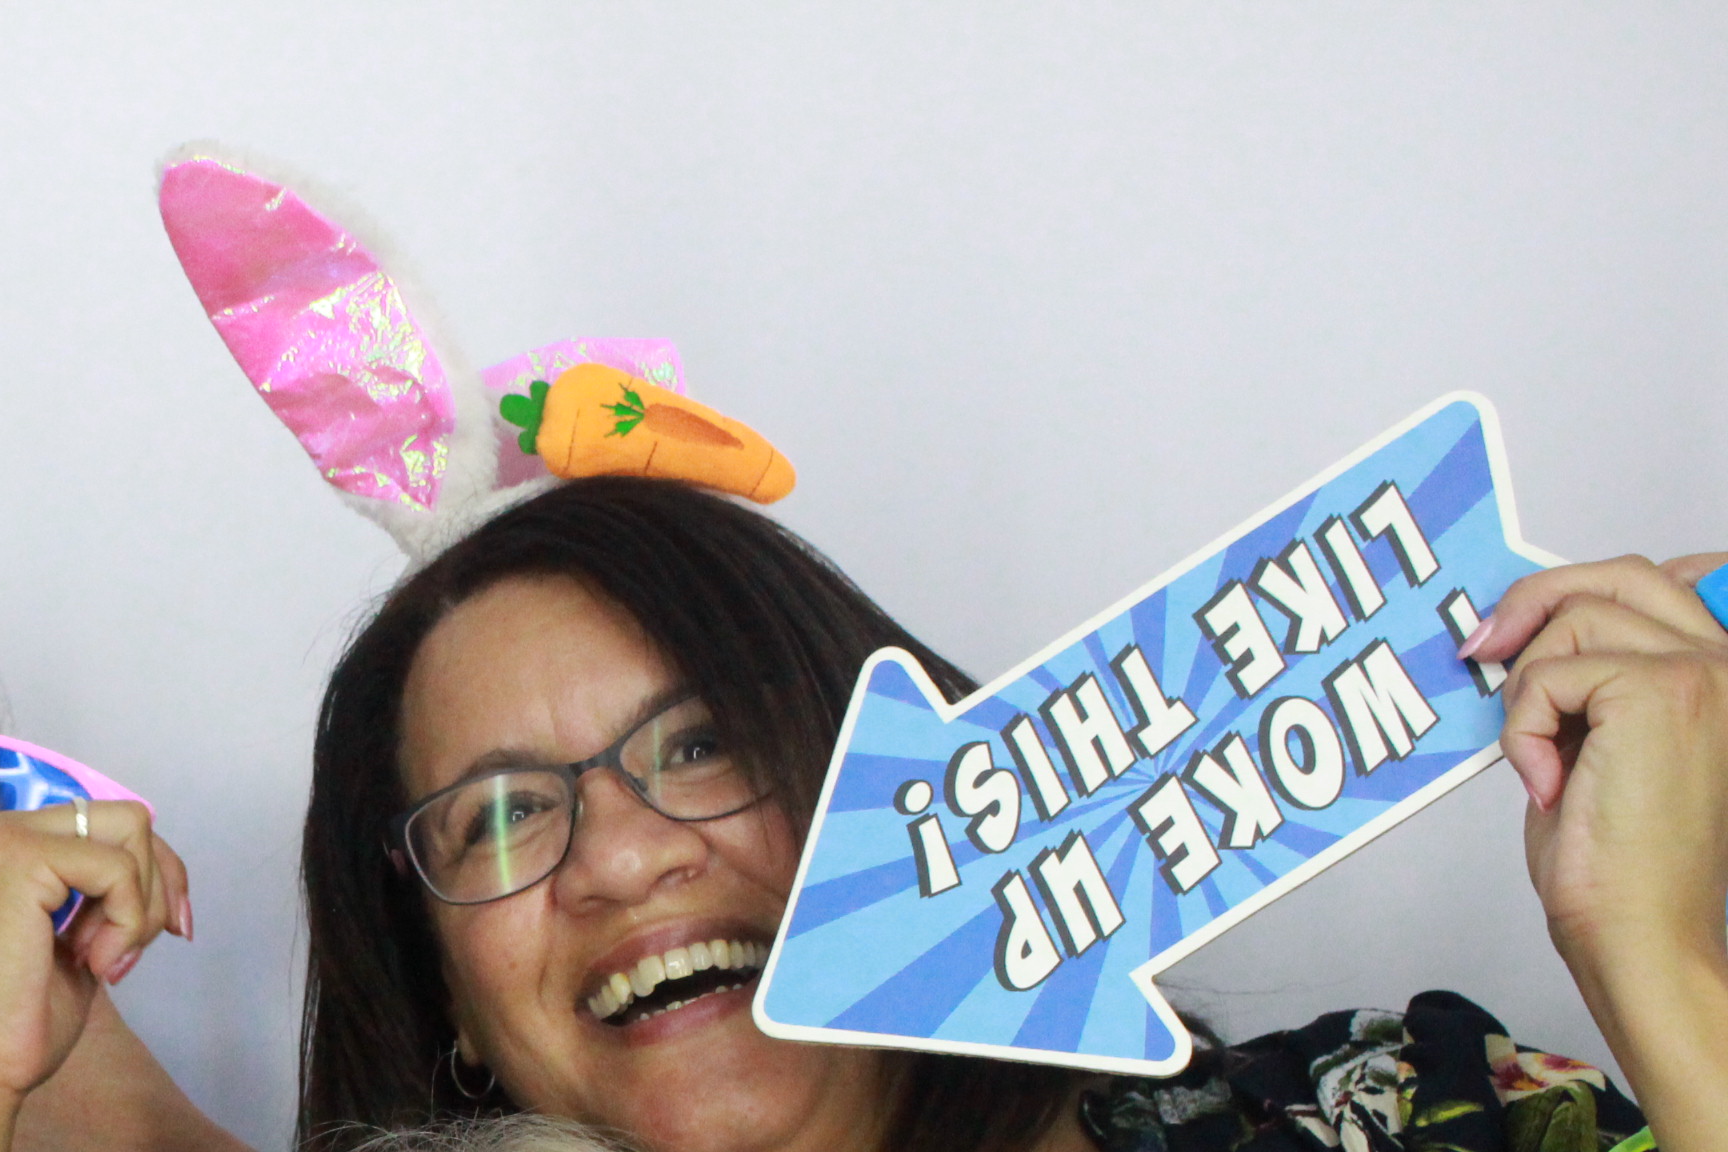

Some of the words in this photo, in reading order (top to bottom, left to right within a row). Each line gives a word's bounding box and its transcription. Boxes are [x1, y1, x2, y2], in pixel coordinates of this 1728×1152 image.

[1193, 480, 1442, 699] LIKE
[892, 643, 1199, 898] THIS!
[1130, 637, 1441, 896] WOKE
[990, 830, 1126, 992] UP
